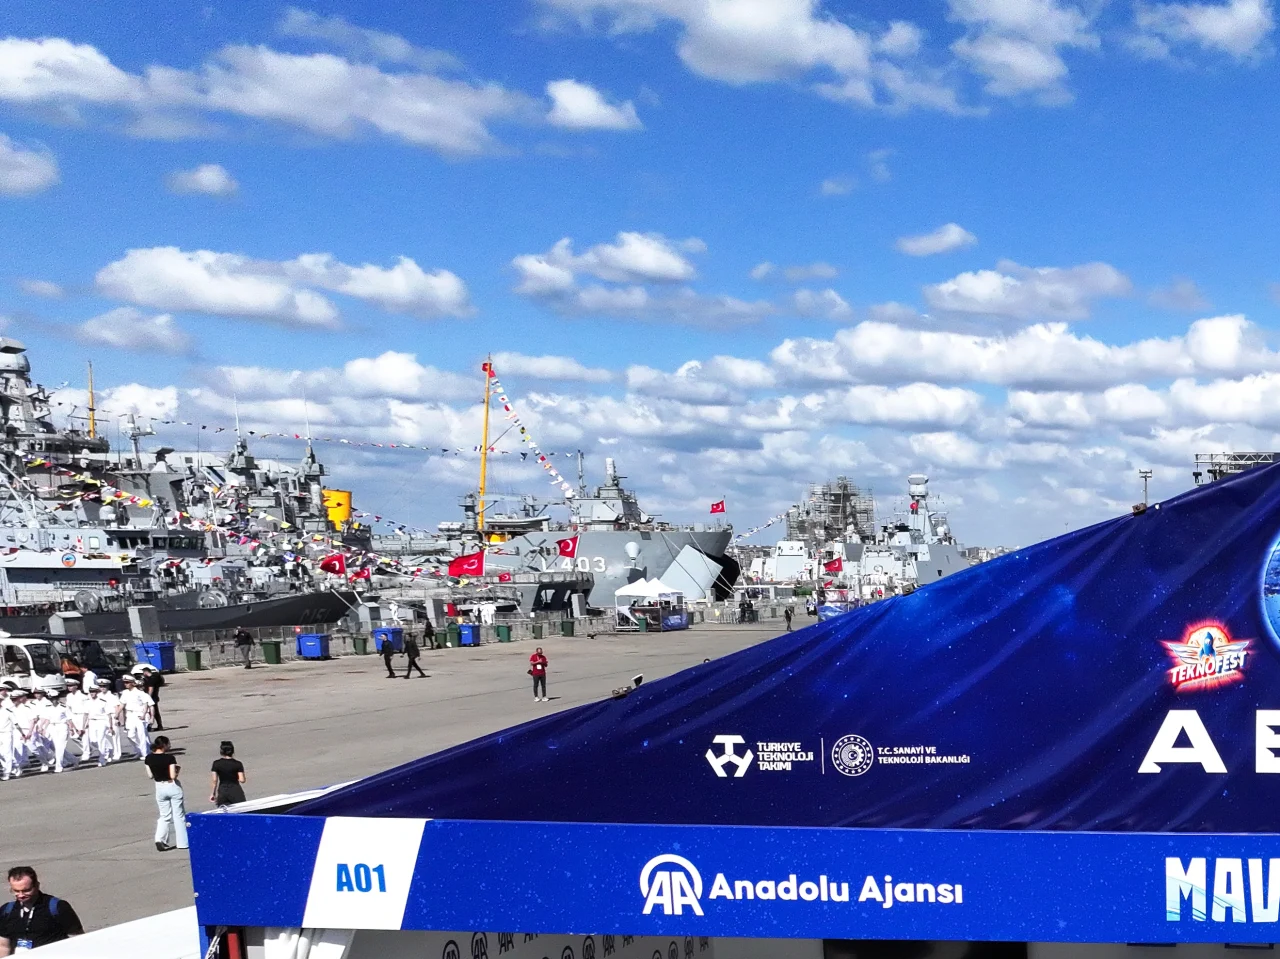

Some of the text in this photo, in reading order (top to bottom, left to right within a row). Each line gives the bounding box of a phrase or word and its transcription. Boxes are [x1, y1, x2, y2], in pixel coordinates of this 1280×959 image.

[560, 557, 606, 573] 403
[1170, 651, 1248, 685] TEKNOFEST
[757, 742, 801, 752] TÜRKİYE
[1138, 710, 1229, 774] A
[757, 751, 814, 761] TEKNOLOJİ
[877, 745, 937, 755] T.C. SANAYİ VE
[878, 754, 971, 764] TEKNOLOJİ BAKANLIĞI
[758, 761, 792, 771] TAKIMI
[336, 863, 387, 893] A01
[709, 873, 849, 902] Anadolu
[858, 875, 963, 909] Ajansı
